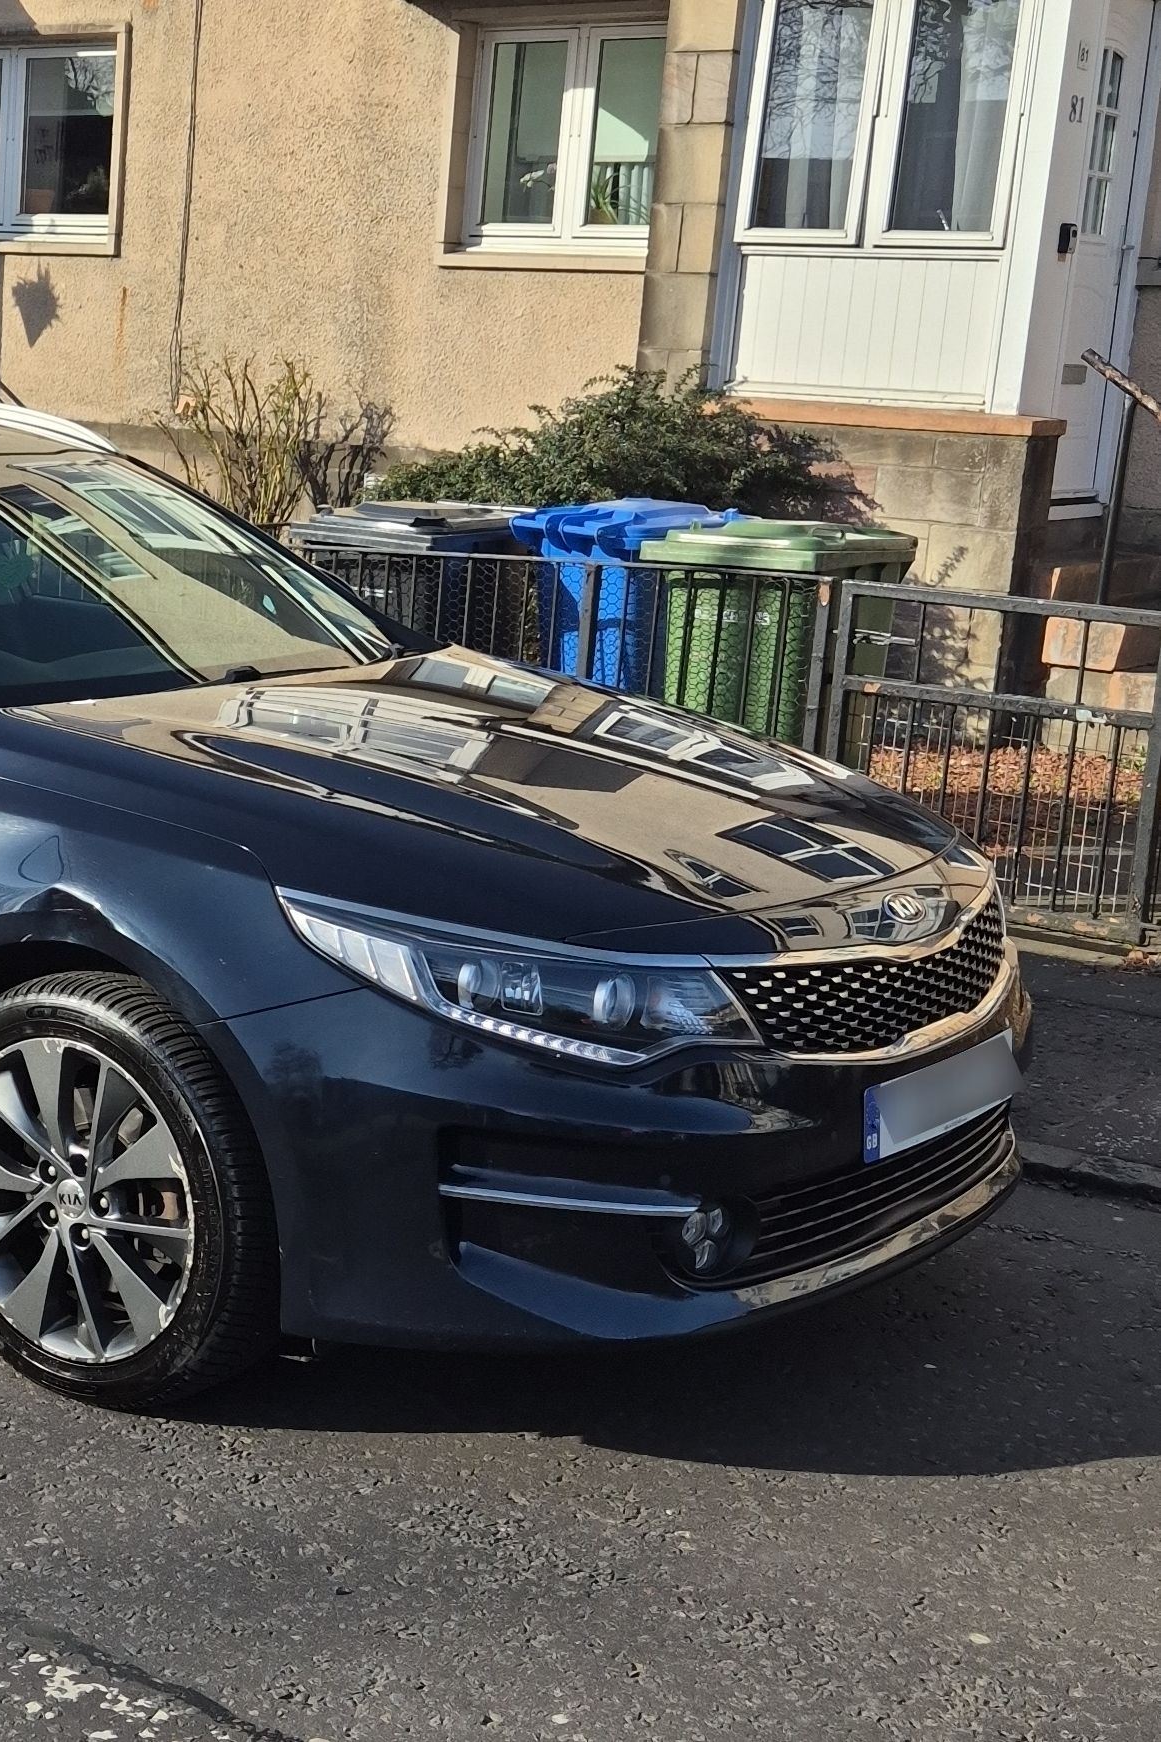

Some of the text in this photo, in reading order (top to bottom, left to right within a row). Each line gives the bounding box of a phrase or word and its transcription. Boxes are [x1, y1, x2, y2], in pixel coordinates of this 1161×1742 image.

[1080, 47, 1089, 63] 81
[1069, 94, 1085, 123] 81
[866, 1133, 878, 1150] GB
[58, 1193, 83, 1206] KIA
